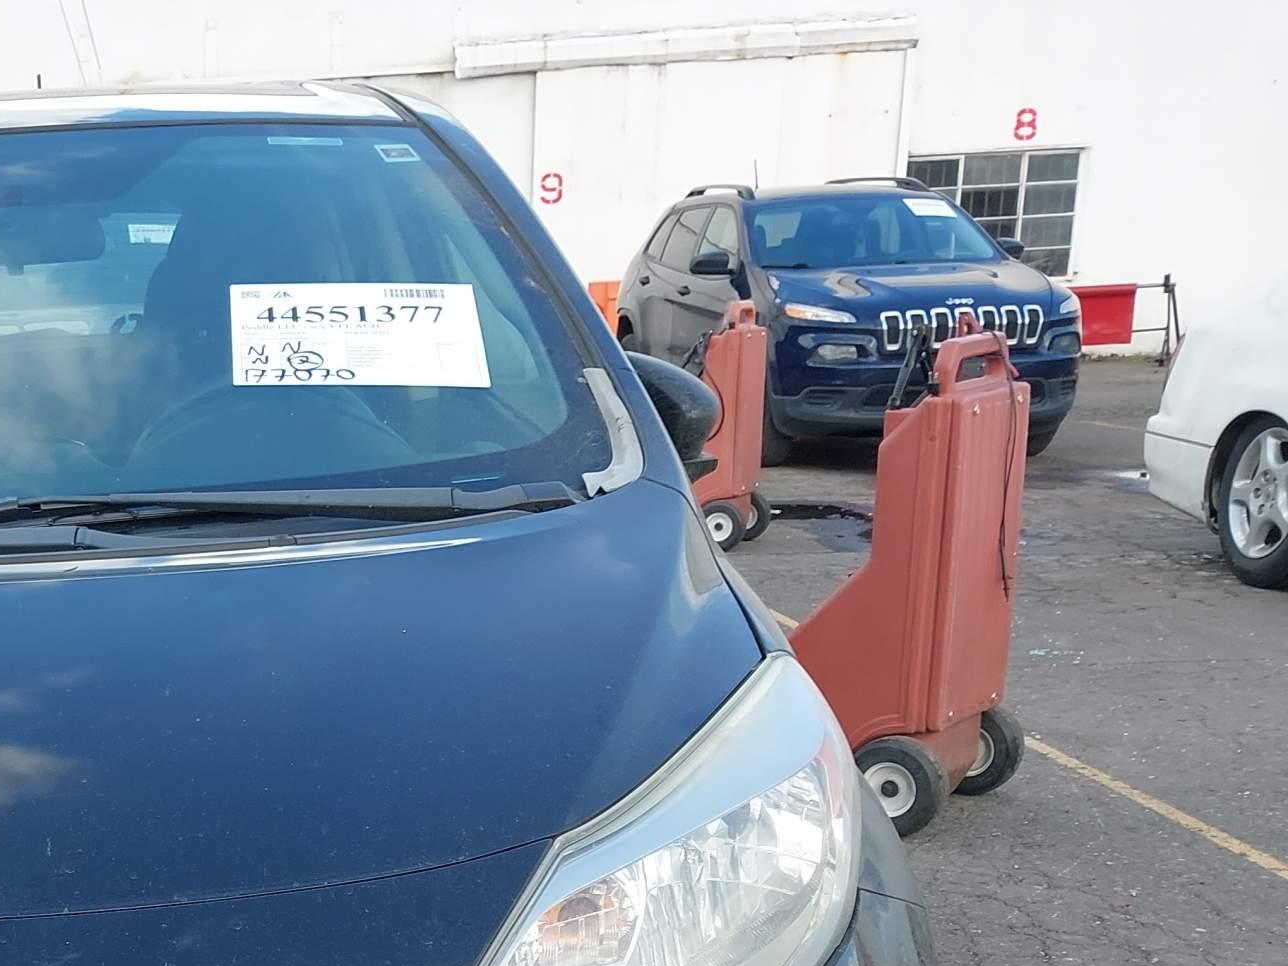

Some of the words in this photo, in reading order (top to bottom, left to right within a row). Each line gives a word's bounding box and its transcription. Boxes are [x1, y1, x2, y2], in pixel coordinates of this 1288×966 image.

[1013, 108, 1038, 141] 8
[540, 173, 564, 204] 9
[256, 305, 443, 323] 44551377
